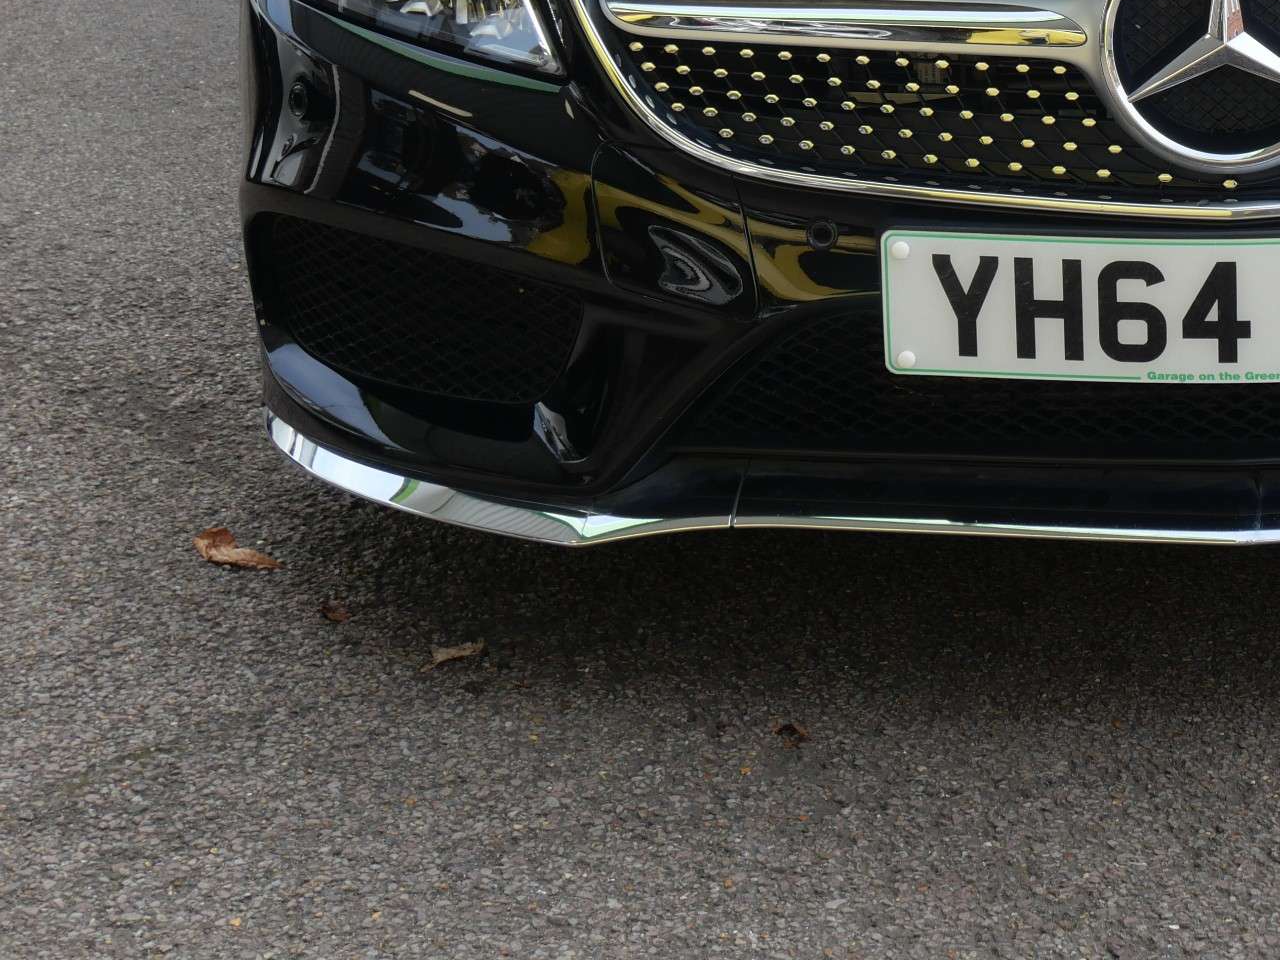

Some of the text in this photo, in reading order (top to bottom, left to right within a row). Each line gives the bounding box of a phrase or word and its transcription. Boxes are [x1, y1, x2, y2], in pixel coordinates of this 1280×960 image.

[931, 253, 1251, 364] YH64
[1147, 371, 1195, 382] Garage
[1199, 373, 1215, 381] on
[1218, 371, 1241, 381] the
